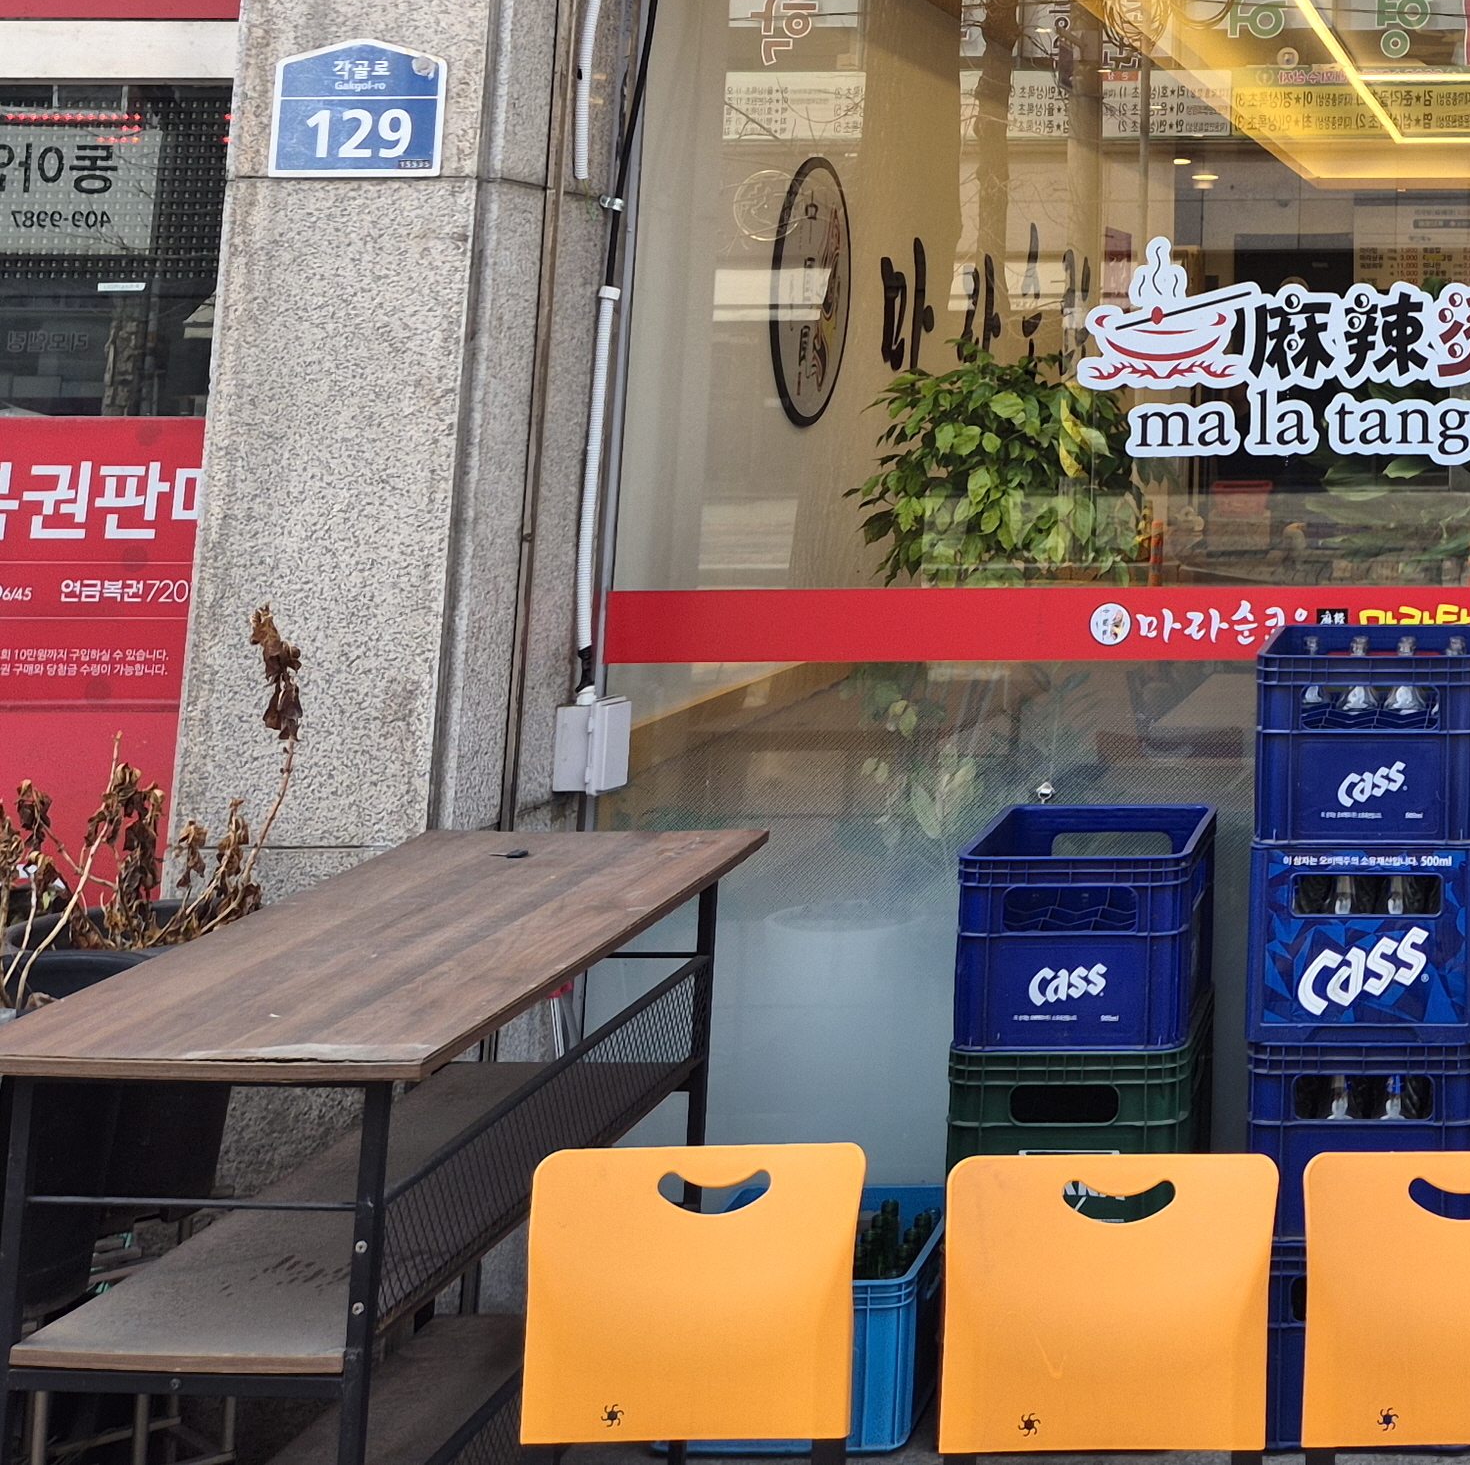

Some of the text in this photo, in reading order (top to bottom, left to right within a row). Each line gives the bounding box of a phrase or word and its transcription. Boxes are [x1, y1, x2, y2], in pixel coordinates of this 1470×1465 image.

[333, 58, 391, 80] 각골로
[334, 80, 387, 93] Gakgol-ro
[306, 107, 413, 160] 129
[1135, 389, 1470, 456] ma la tang
[0, 460, 204, 540] 권판
[0, 585, 33, 602] 6/45
[69, 648, 111, 661] 구입하실
[112, 648, 124, 661] 수
[125, 648, 170, 661] 있습니다.
[1336, 760, 1408, 807] Cass
[1283, 855, 1292, 866] 이
[1420, 855, 1453, 867] 500ml
[1028, 962, 1108, 1006] Cass
[1297, 926, 1430, 1015] Cass
